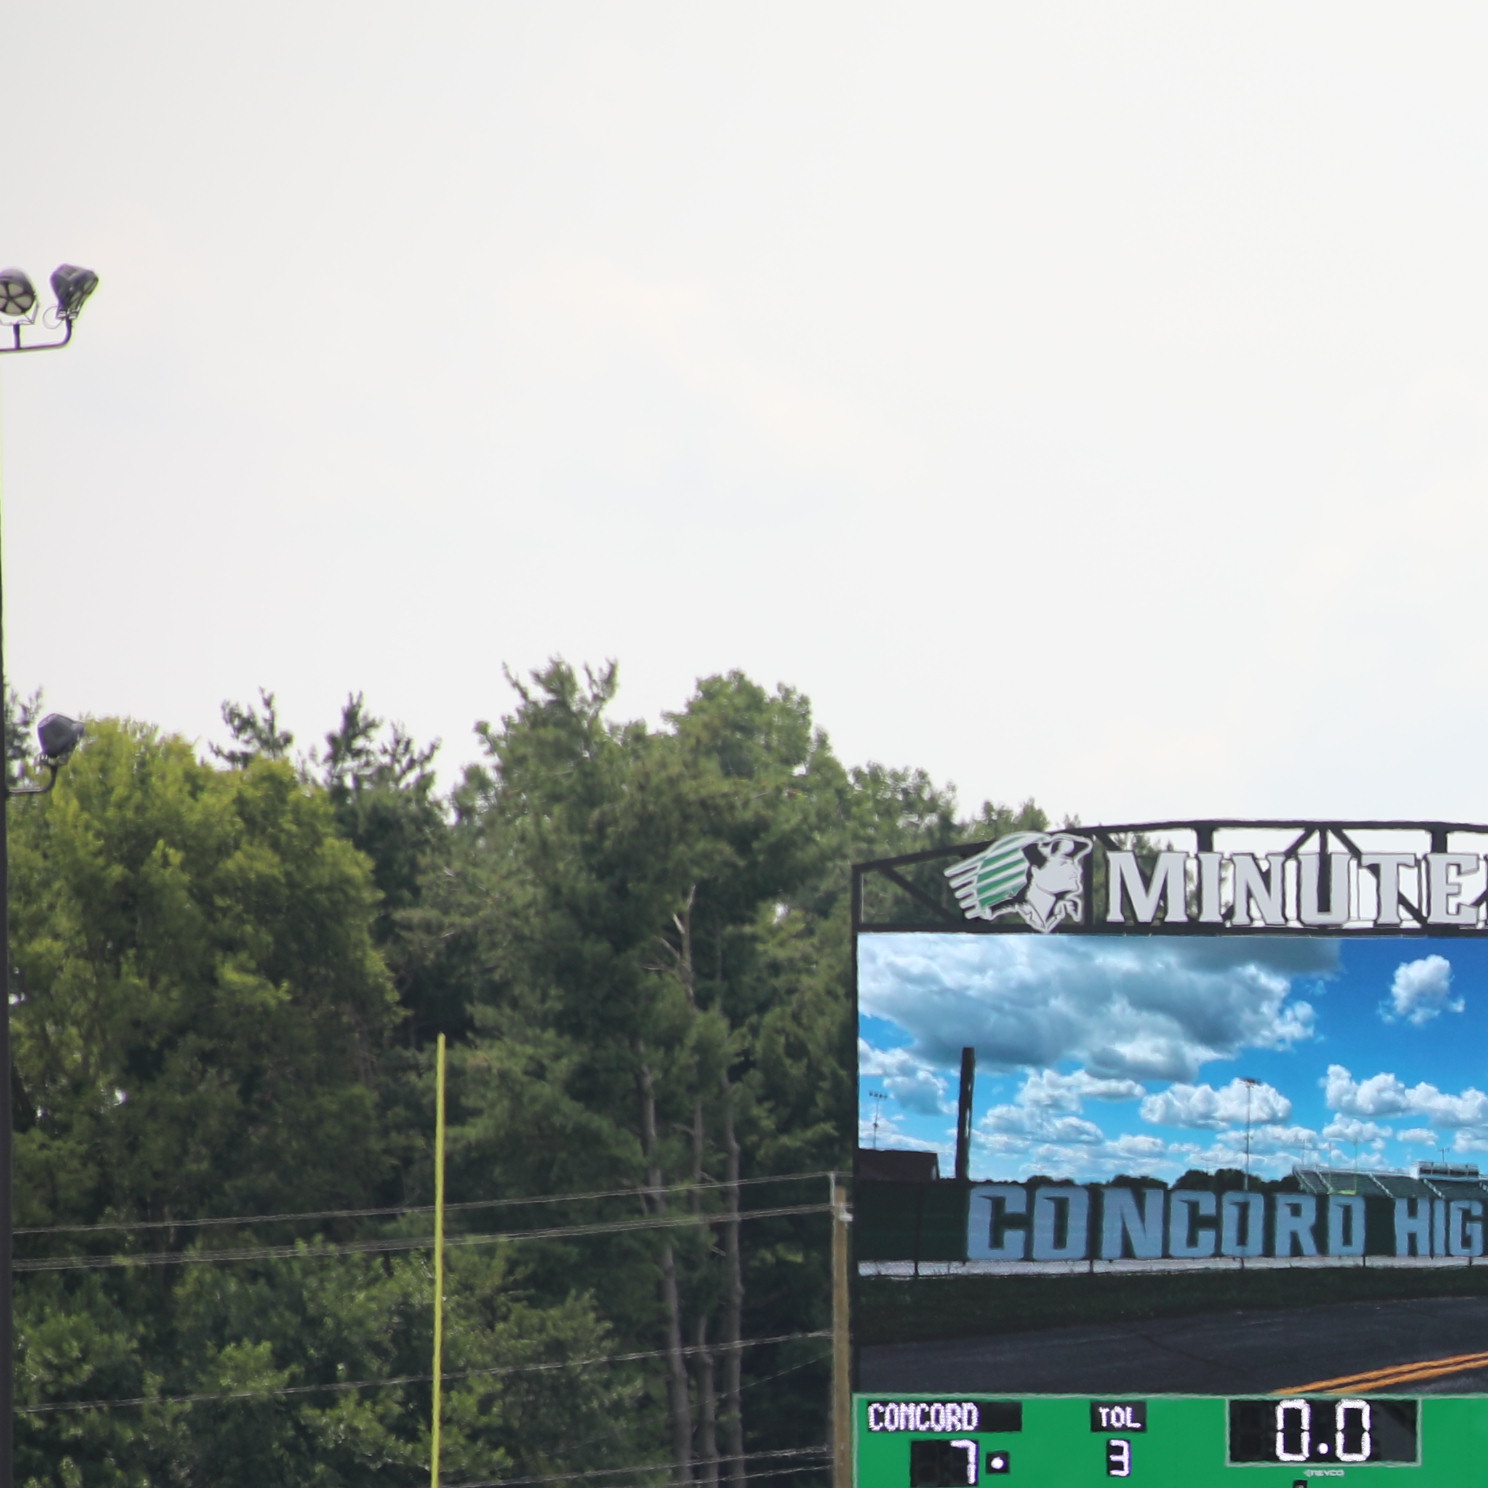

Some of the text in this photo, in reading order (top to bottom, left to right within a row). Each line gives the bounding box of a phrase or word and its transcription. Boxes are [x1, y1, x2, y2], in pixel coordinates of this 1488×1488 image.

[965, 1184, 1367, 1262] CONCORD
[867, 1402, 980, 1432] CONCORD
[1099, 1405, 1141, 1429] TOL
[1275, 1398, 1371, 1462] 0.0
[950, 1439, 978, 1485] 7
[1108, 1439, 1131, 1477] 3
